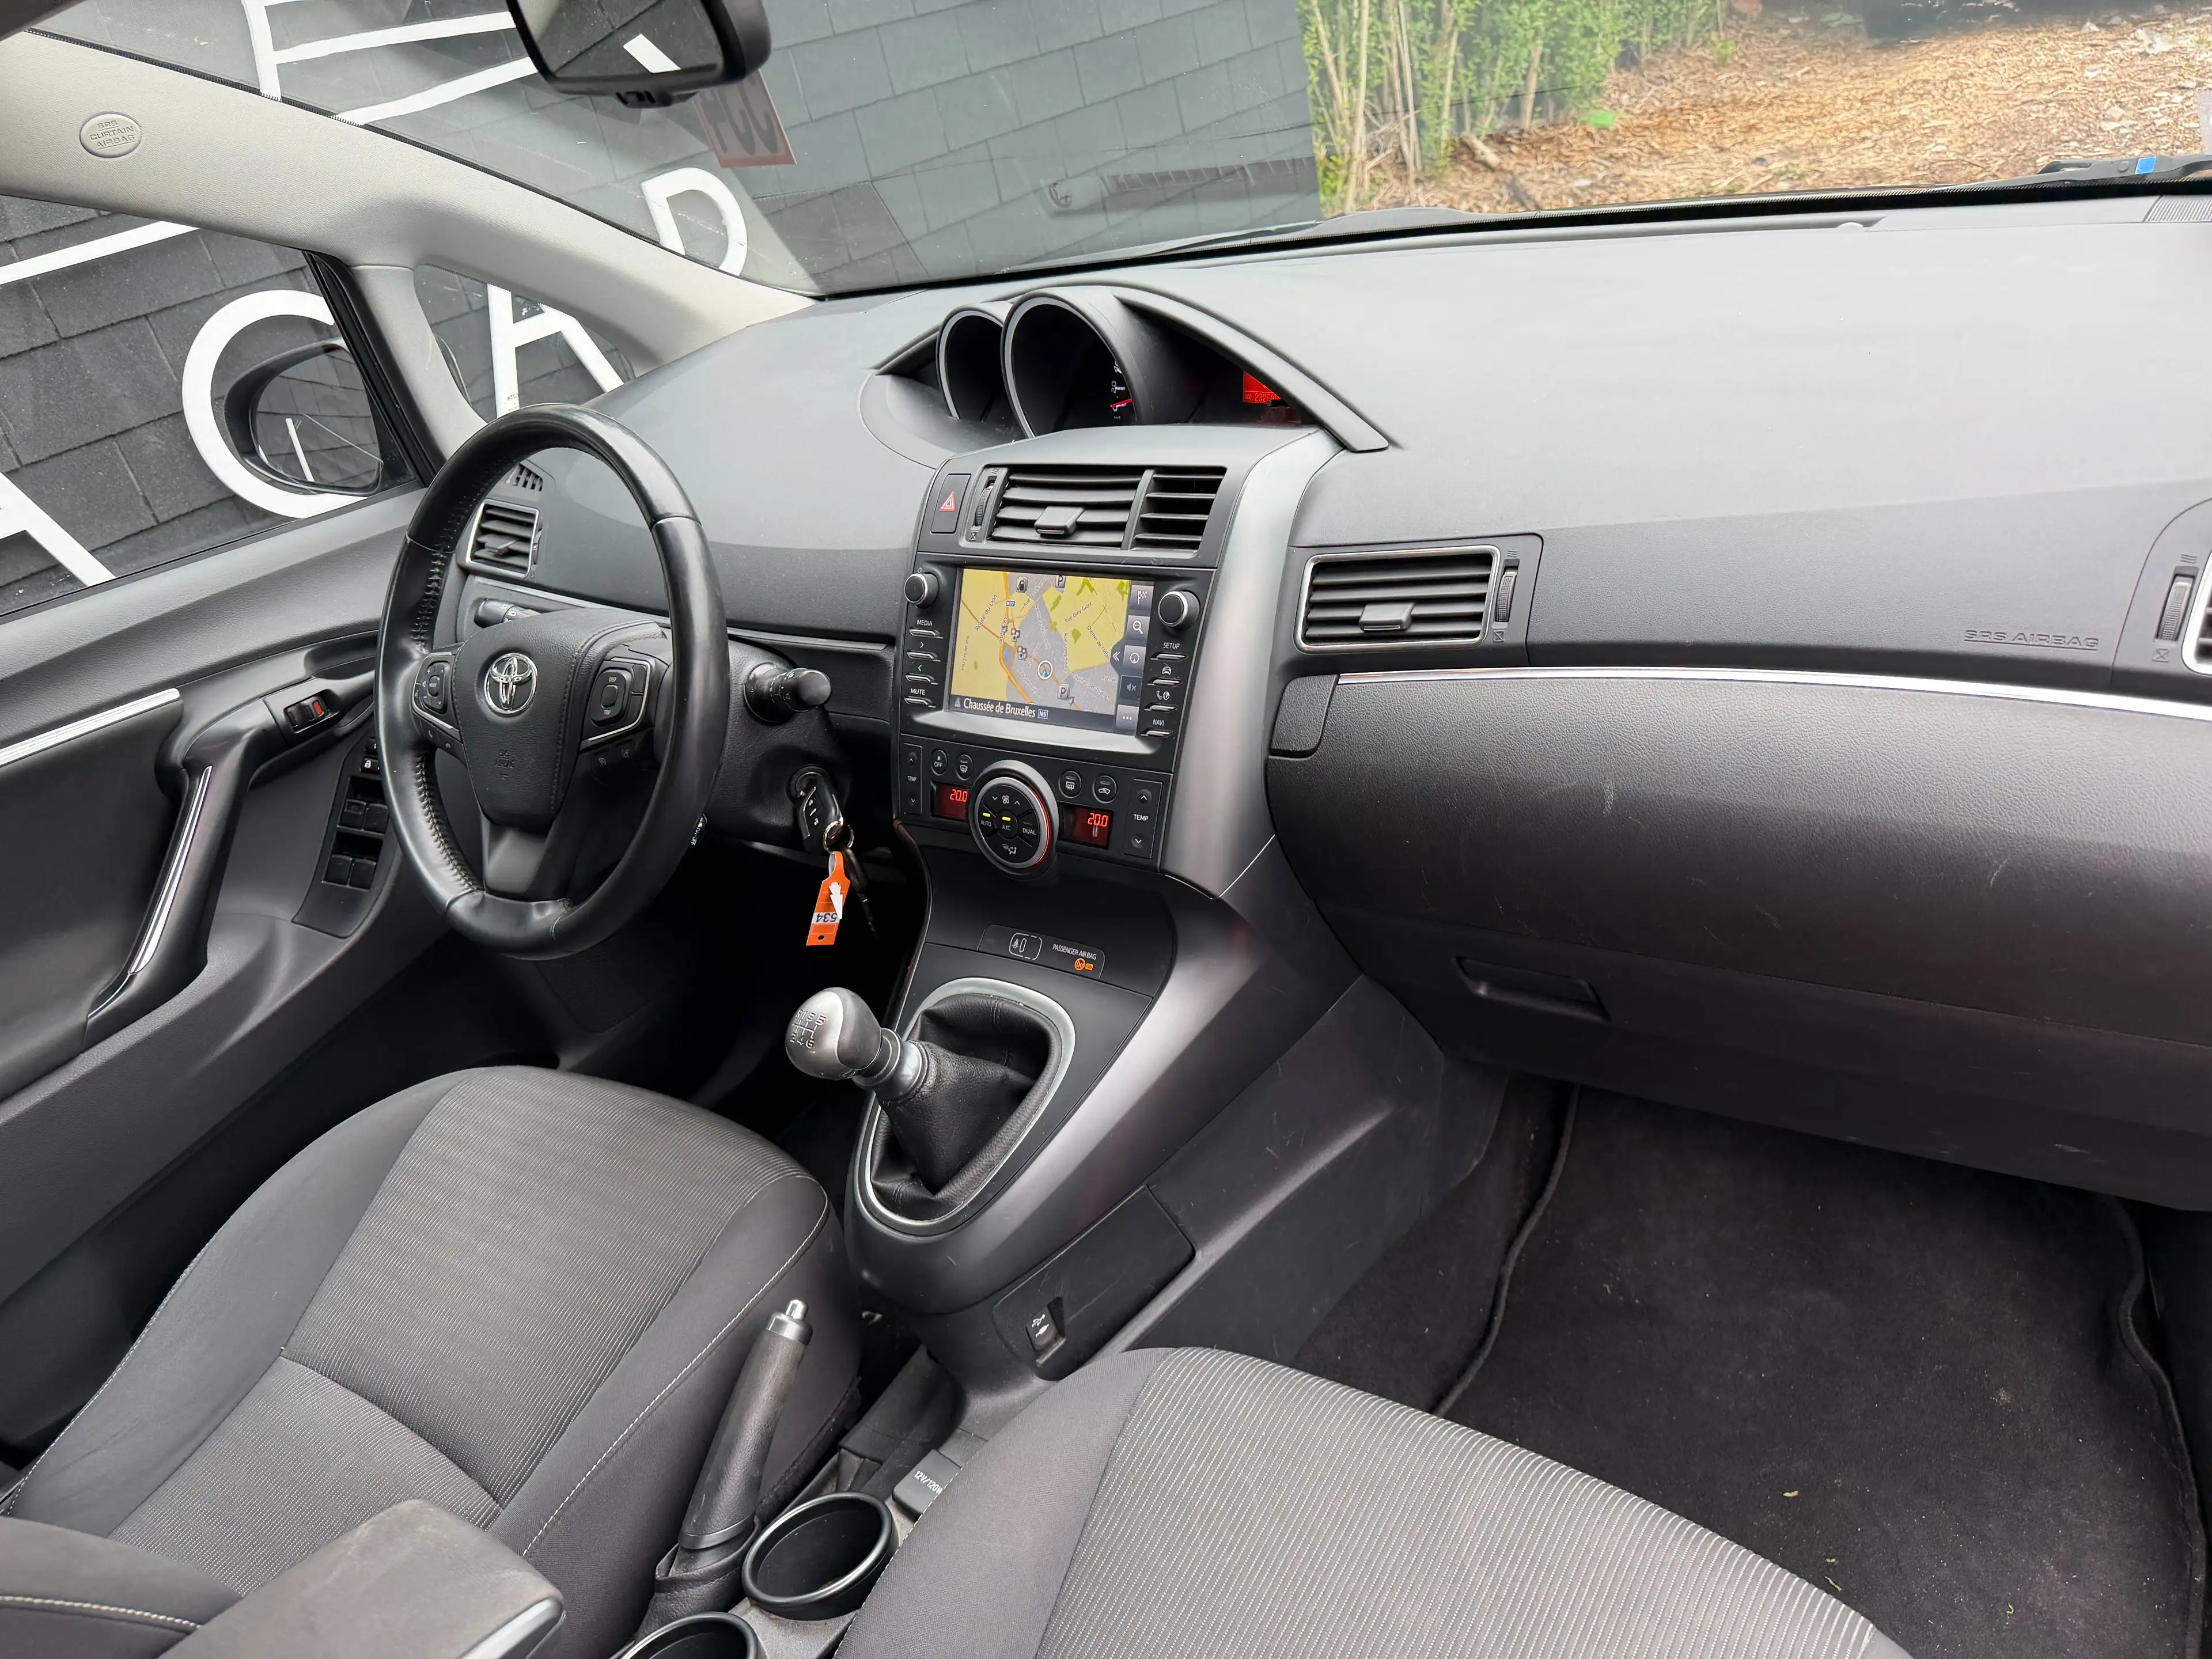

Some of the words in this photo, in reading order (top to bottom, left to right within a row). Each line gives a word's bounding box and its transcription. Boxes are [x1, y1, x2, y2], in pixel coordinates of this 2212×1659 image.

[97, 120, 119, 129] SRS
[90, 126, 134, 141] CURTAIN
[97, 134, 135, 147] AIRBAG
[975, 615, 986, 631] Route
[989, 594, 997, 607] Lion
[1087, 625, 1097, 641] Chemin
[1964, 630, 2007, 642] SRS
[2012, 632, 2099, 648] AIRBAG
[964, 698, 993, 712] Chaussée
[995, 702, 1003, 713] de
[1005, 703, 1036, 718] Bruxelles
[950, 789, 968, 802] 20.0
[1088, 813, 1108, 827] 20.0
[815, 912, 838, 923] 534
[1052, 944, 1079, 956] PASSENGER
